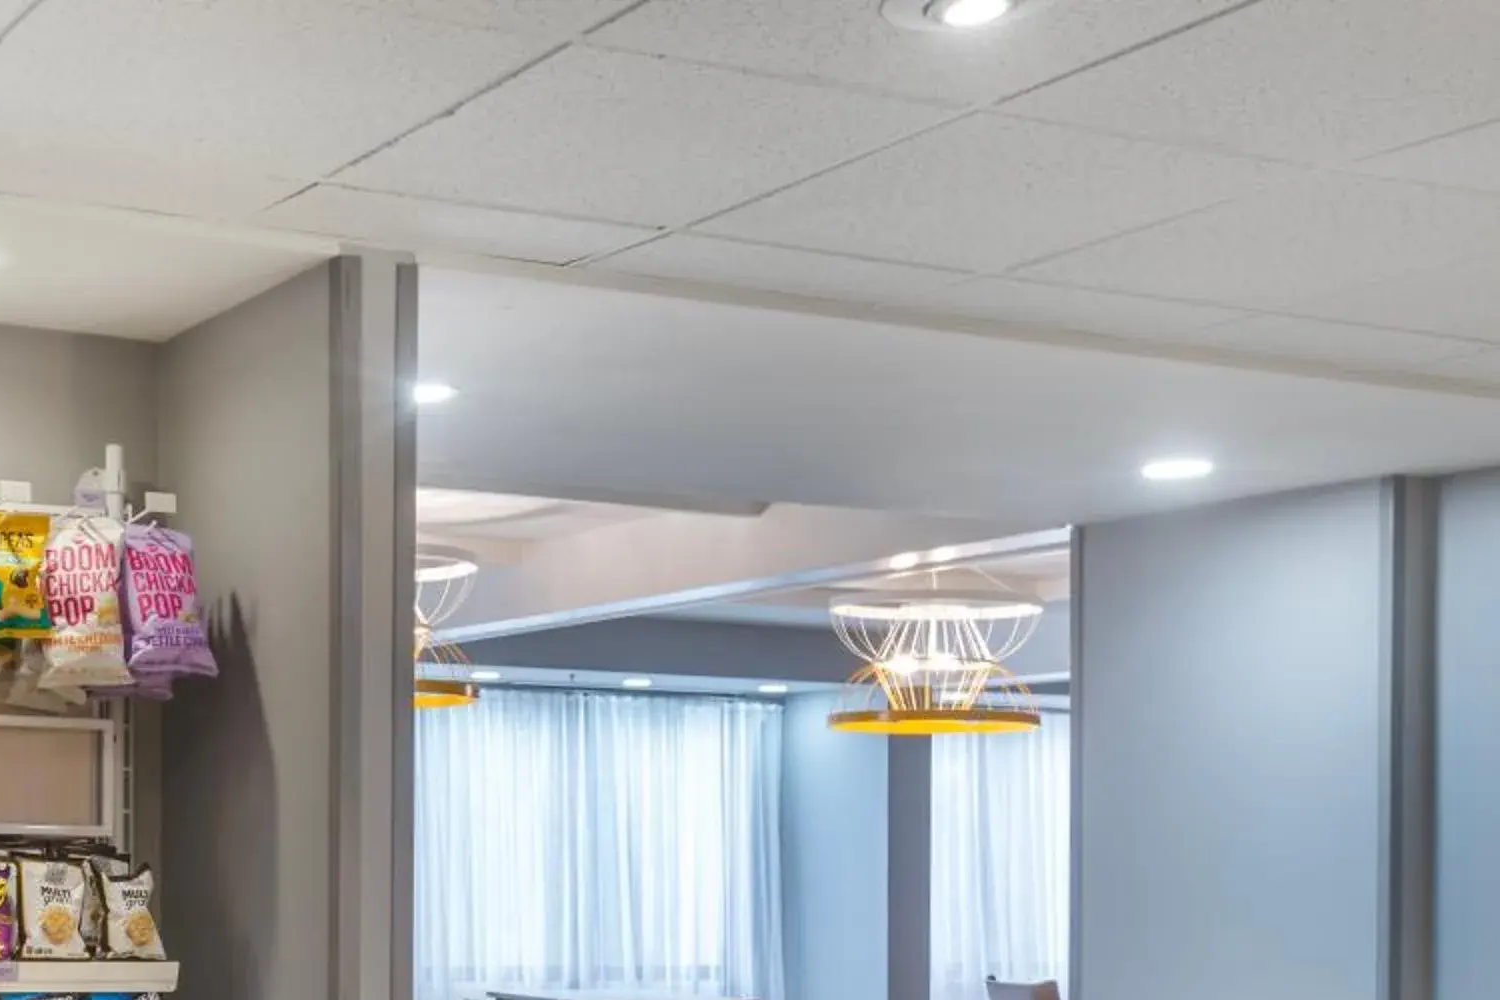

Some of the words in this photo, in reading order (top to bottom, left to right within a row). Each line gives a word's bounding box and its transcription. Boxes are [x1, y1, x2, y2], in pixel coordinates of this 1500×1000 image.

[45, 543, 117, 573] BOOM
[126, 547, 194, 576] BOOM
[46, 571, 118, 598] CHICKA
[132, 571, 196, 595] CHICKA
[48, 595, 95, 627] POP
[137, 592, 183, 623] POP
